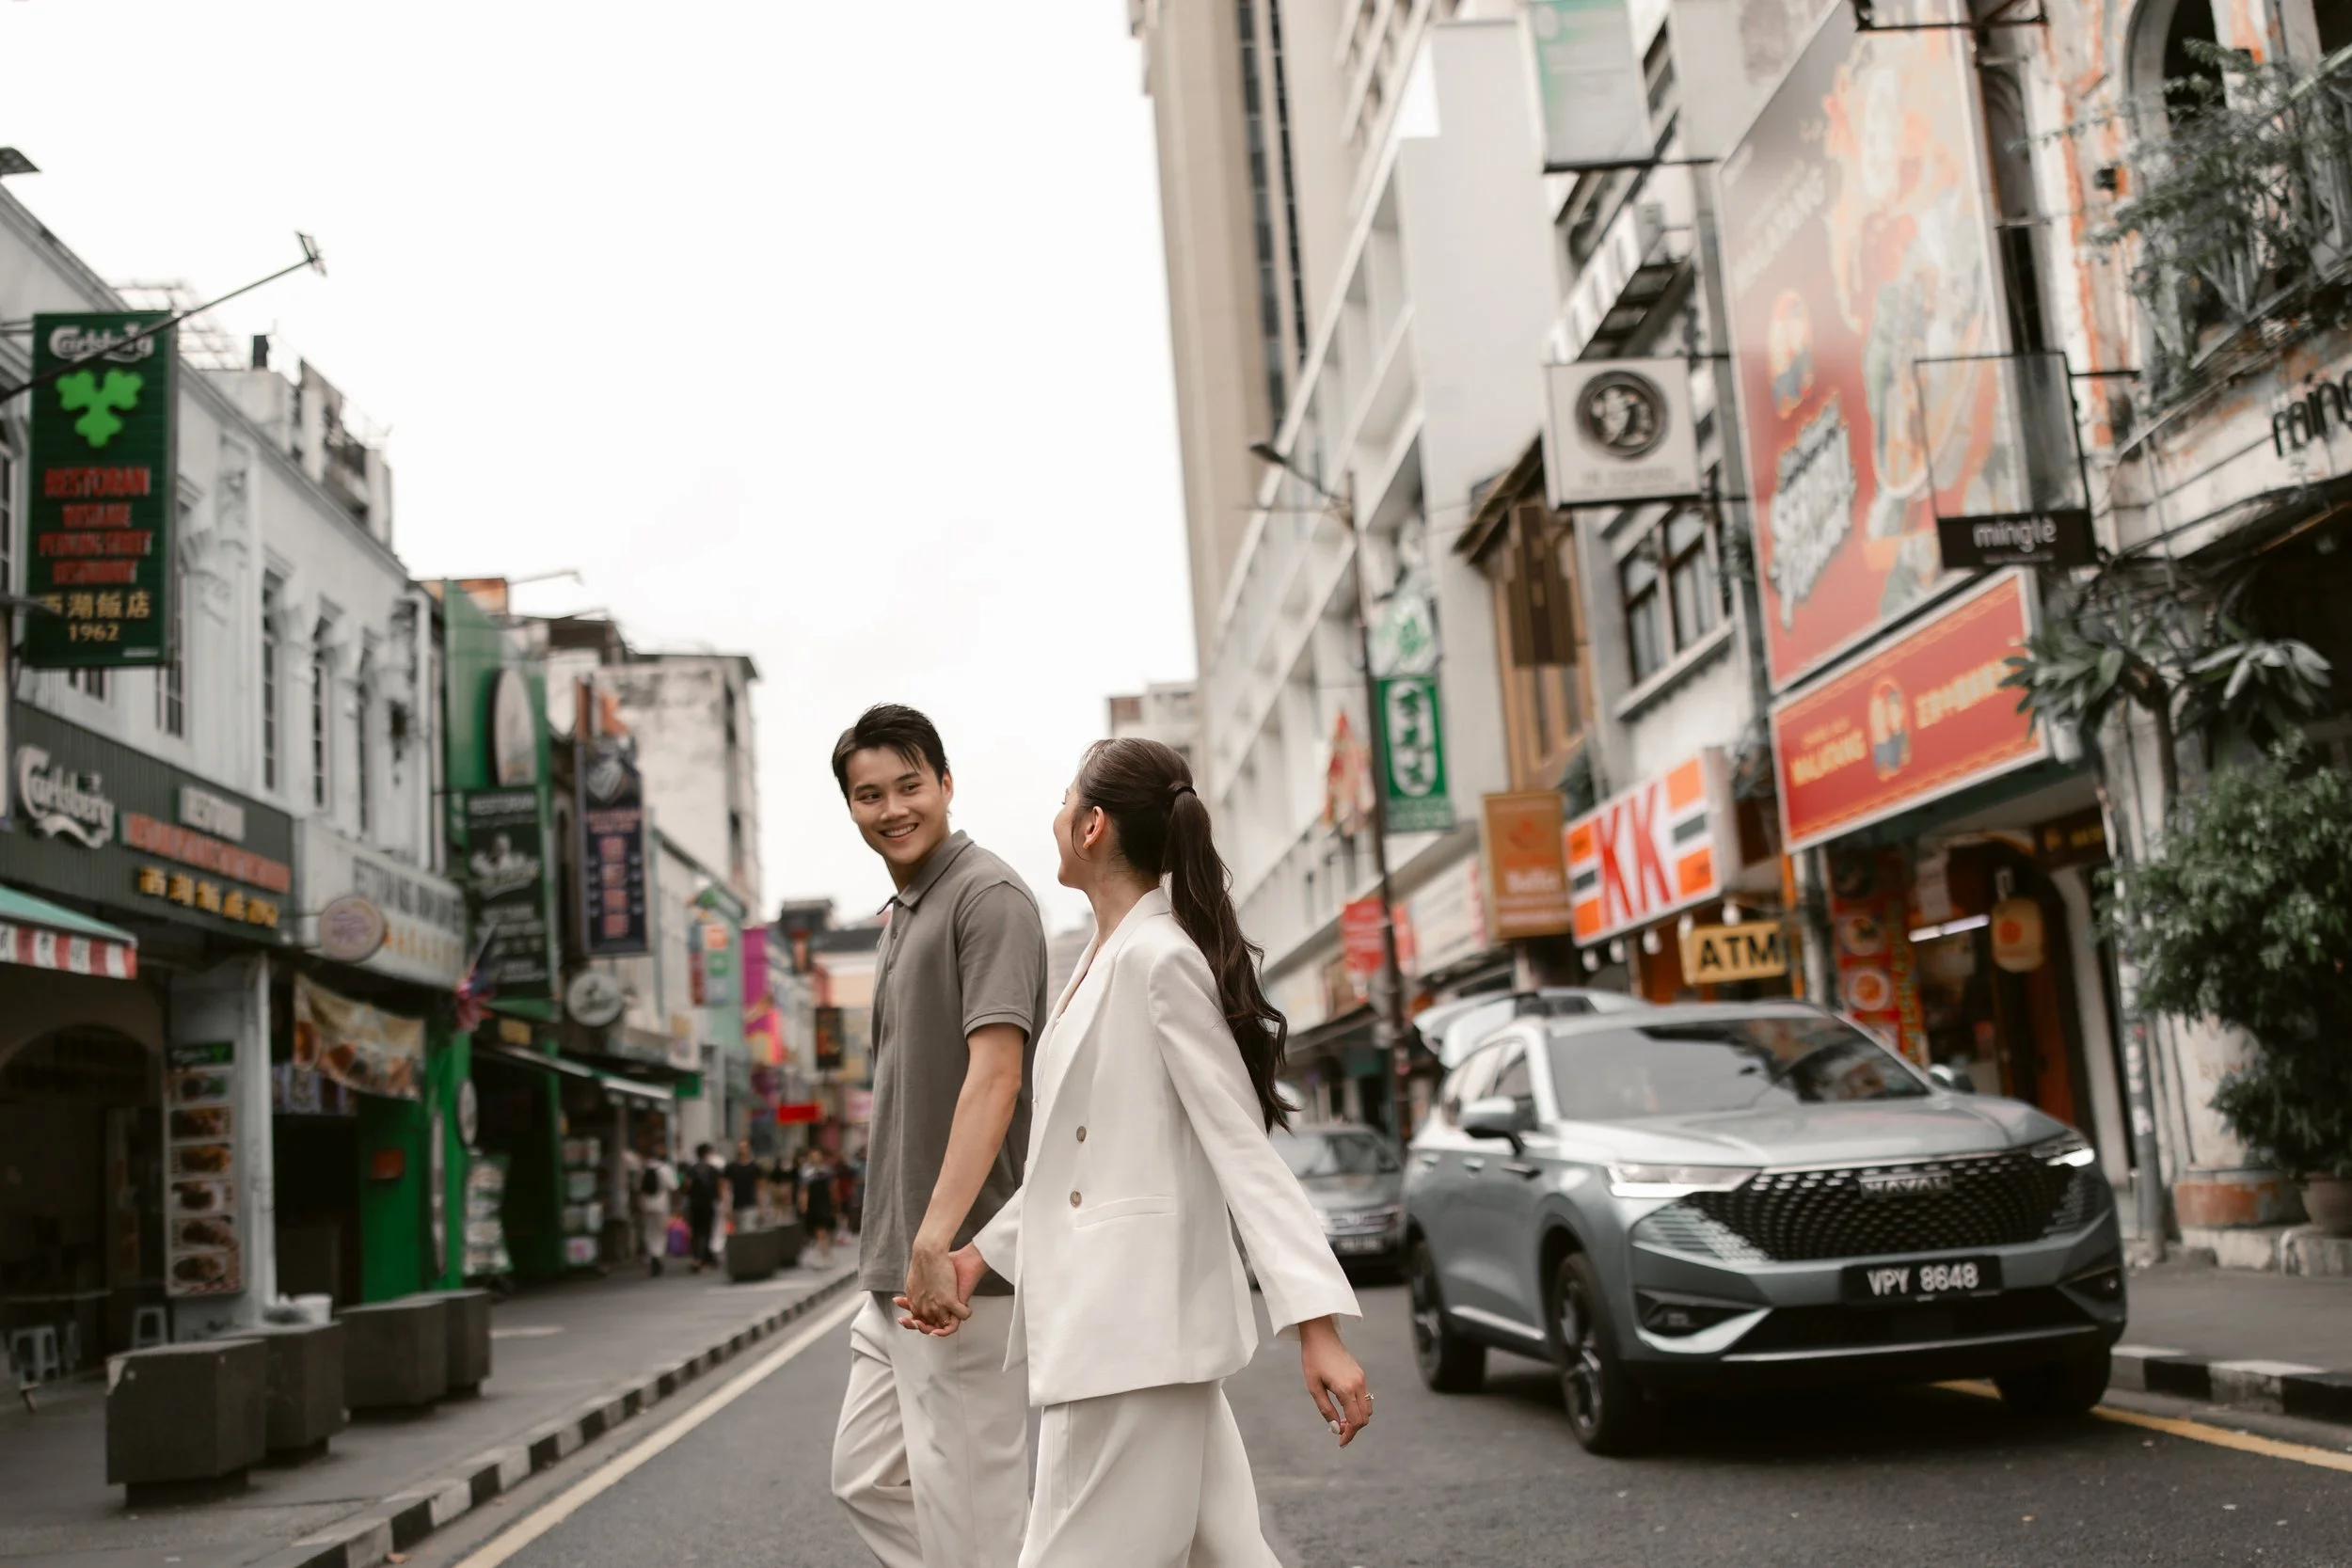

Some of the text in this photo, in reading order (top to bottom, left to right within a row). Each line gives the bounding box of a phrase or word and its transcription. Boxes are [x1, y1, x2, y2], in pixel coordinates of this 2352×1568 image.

[1973, 515, 2057, 552] mingle
[69, 621, 119, 641] 1962
[17, 745, 115, 849] Carlsberg
[1595, 782, 1672, 929] KK
[1699, 931, 1782, 973] ATM
[1867, 1261, 1979, 1296] VPY 8648
